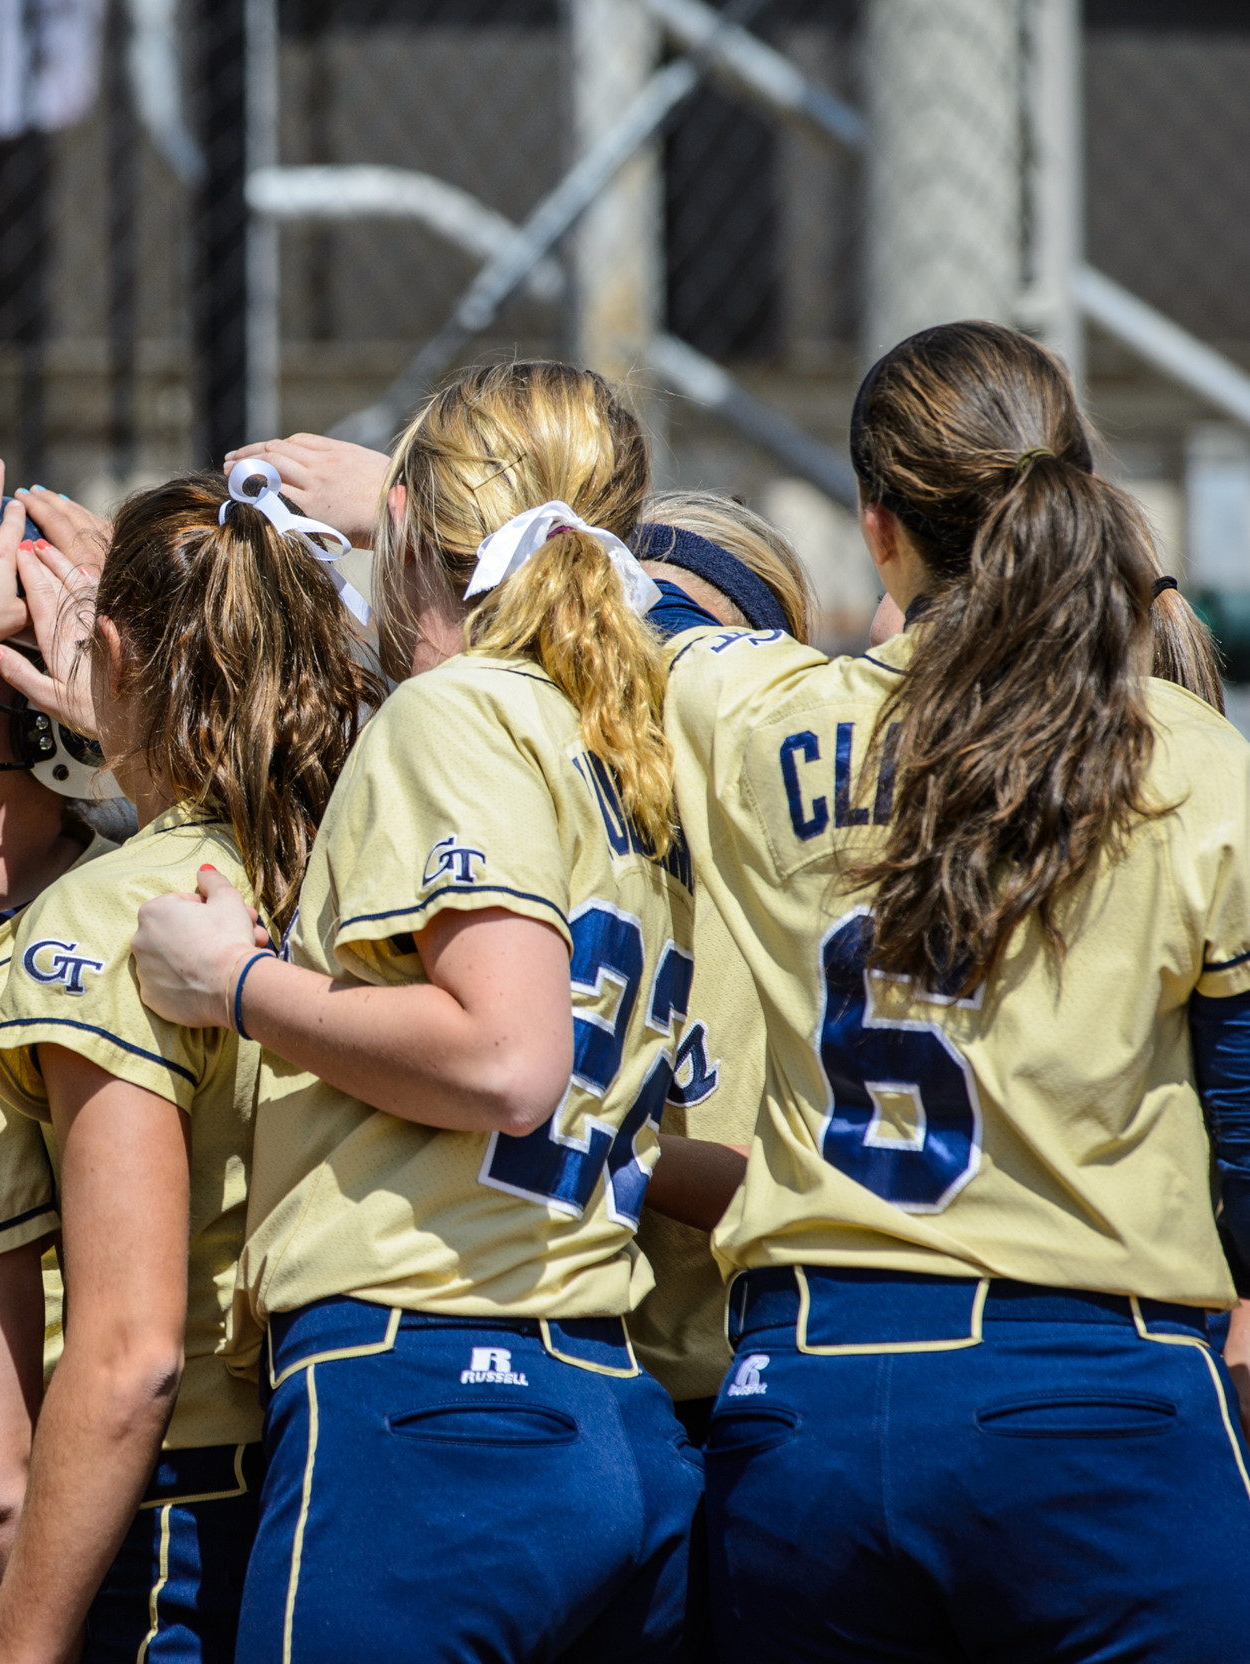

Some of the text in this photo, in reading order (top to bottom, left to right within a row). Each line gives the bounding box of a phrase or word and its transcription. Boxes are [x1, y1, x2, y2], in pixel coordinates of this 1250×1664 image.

[422, 834, 487, 889] GT
[23, 938, 106, 996] GT
[817, 905, 984, 1216] 6
[460, 1369, 529, 1387] RUSSELL
[471, 1346, 512, 1373] R
